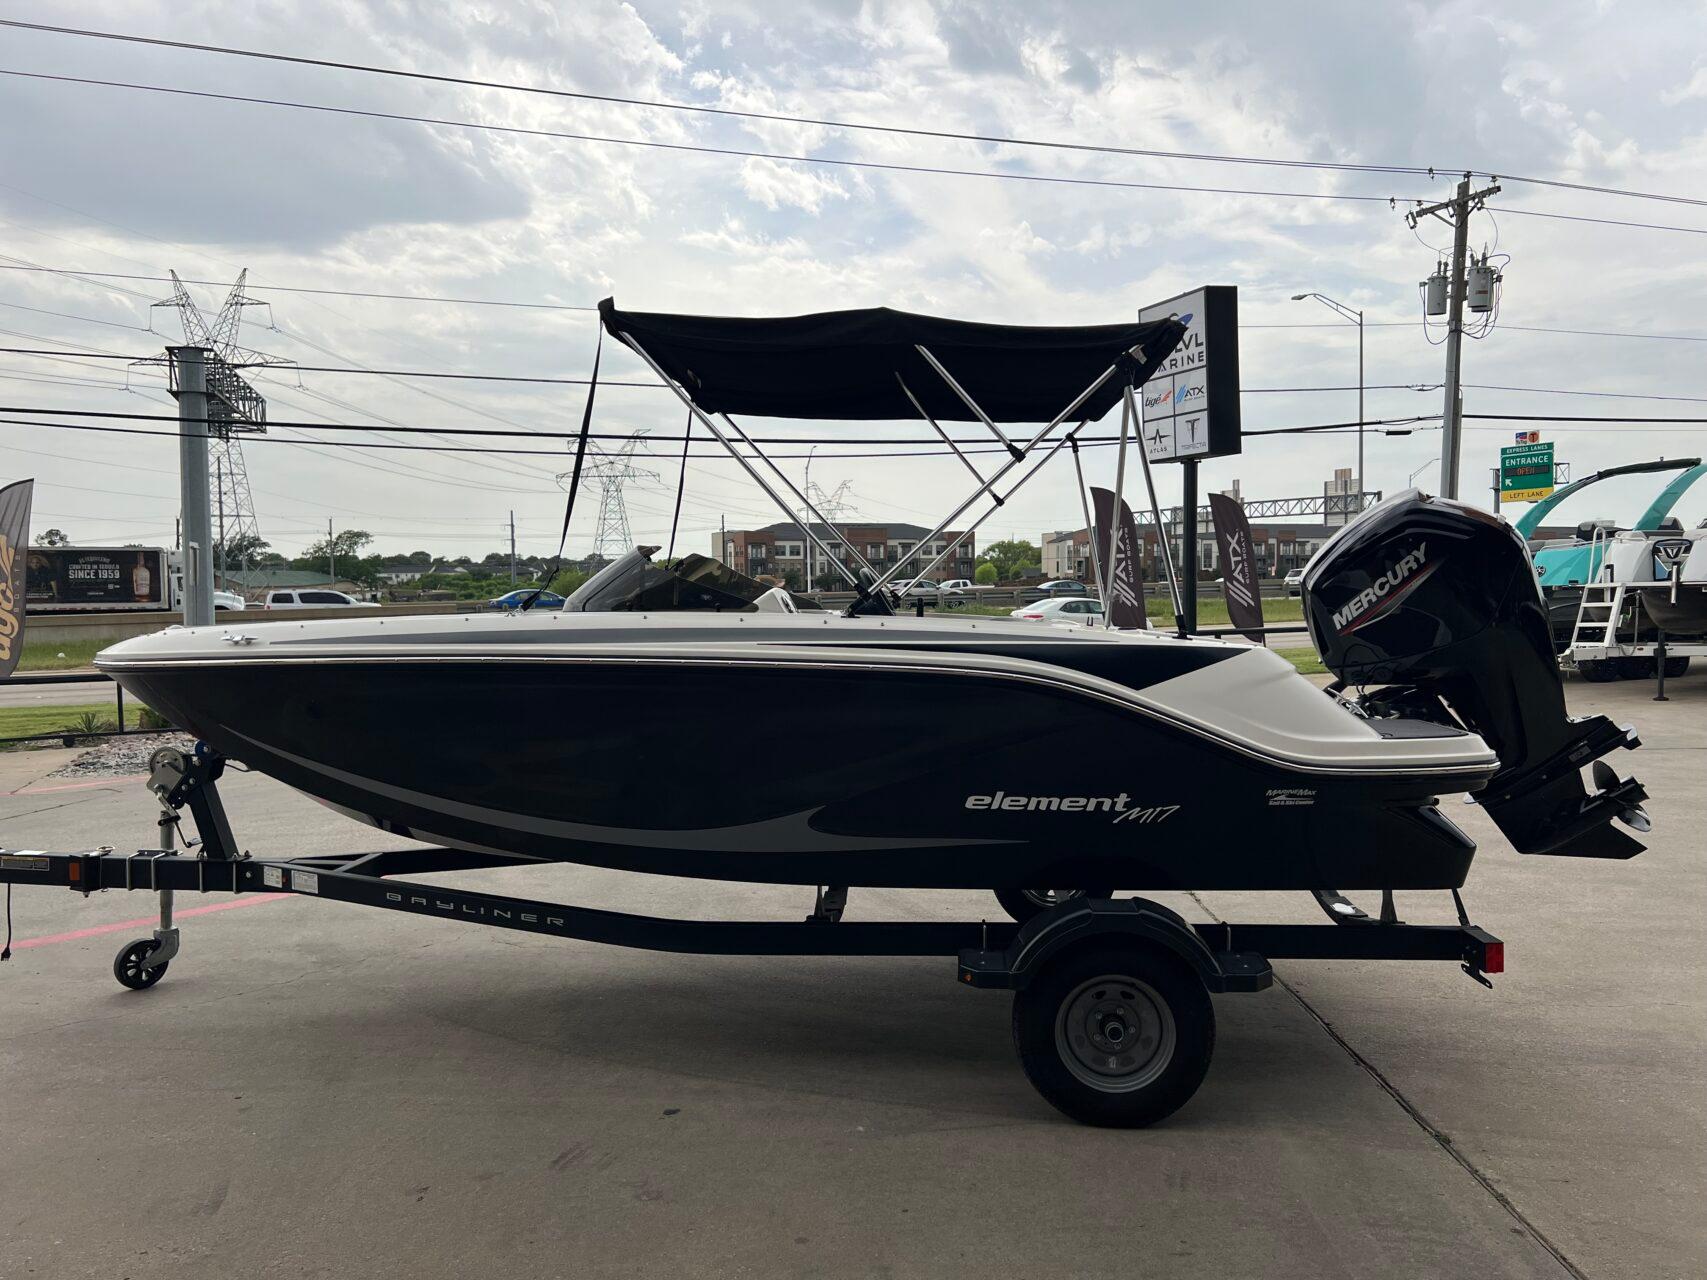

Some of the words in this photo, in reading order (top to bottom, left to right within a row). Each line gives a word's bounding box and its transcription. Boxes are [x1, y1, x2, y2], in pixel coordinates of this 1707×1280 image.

[1157, 351, 1205, 373] ARINE
[1184, 385, 1205, 399] ATX
[1506, 456, 1548, 466] ENTRANCE
[1517, 467, 1535, 476] OPEN
[1226, 531, 1244, 584] ATX
[68, 570, 96, 579] SINCE
[98, 570, 120, 579] 1959
[1331, 542, 1428, 631] MERCURY
[964, 791, 1131, 812] element
[386, 892, 564, 927] BAYLINER
